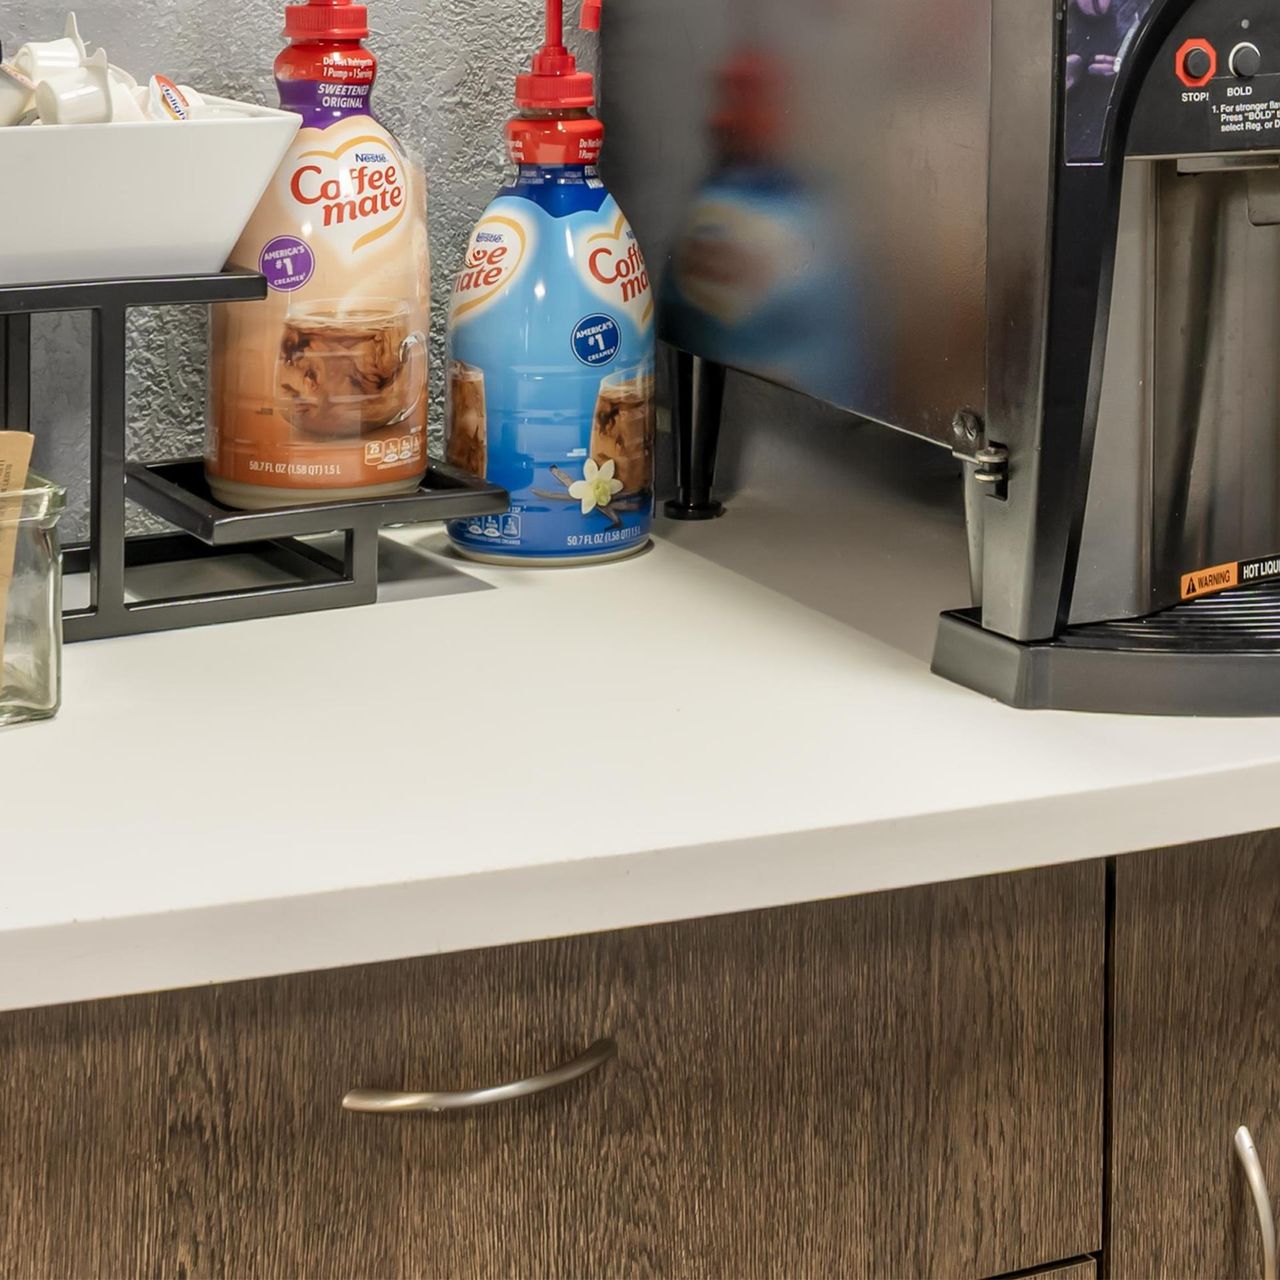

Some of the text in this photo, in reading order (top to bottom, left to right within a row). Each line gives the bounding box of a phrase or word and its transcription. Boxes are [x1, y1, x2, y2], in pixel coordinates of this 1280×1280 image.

[1181, 92, 1209, 103] STOP!
[1226, 86, 1253, 97] BOLD
[322, 96, 363, 109] ORIGINAL
[1211, 105, 1219, 114] 1.
[1220, 104, 1234, 113] For
[1235, 102, 1268, 113] stronger
[1221, 113, 1243, 122] Press
[1244, 110, 1276, 120] "BOLD"
[1221, 123, 1244, 132] select
[1245, 121, 1263, 131] Reg.
[1264, 121, 1273, 129] or
[290, 165, 397, 205] Cofee
[323, 186, 402, 227] mate
[264, 245, 305, 261] AMERICA'S
[576, 320, 614, 339] AMERICA'S
[265, 462, 274, 473] FL
[275, 463, 287, 474] OZ
[308, 463, 323, 476] QT)
[567, 535, 583, 546] 50.7
[584, 534, 593, 545] FL
[594, 533, 604, 544] OZ
[1197, 569, 1230, 589] WARNING
[1243, 563, 1260, 580] HOT
